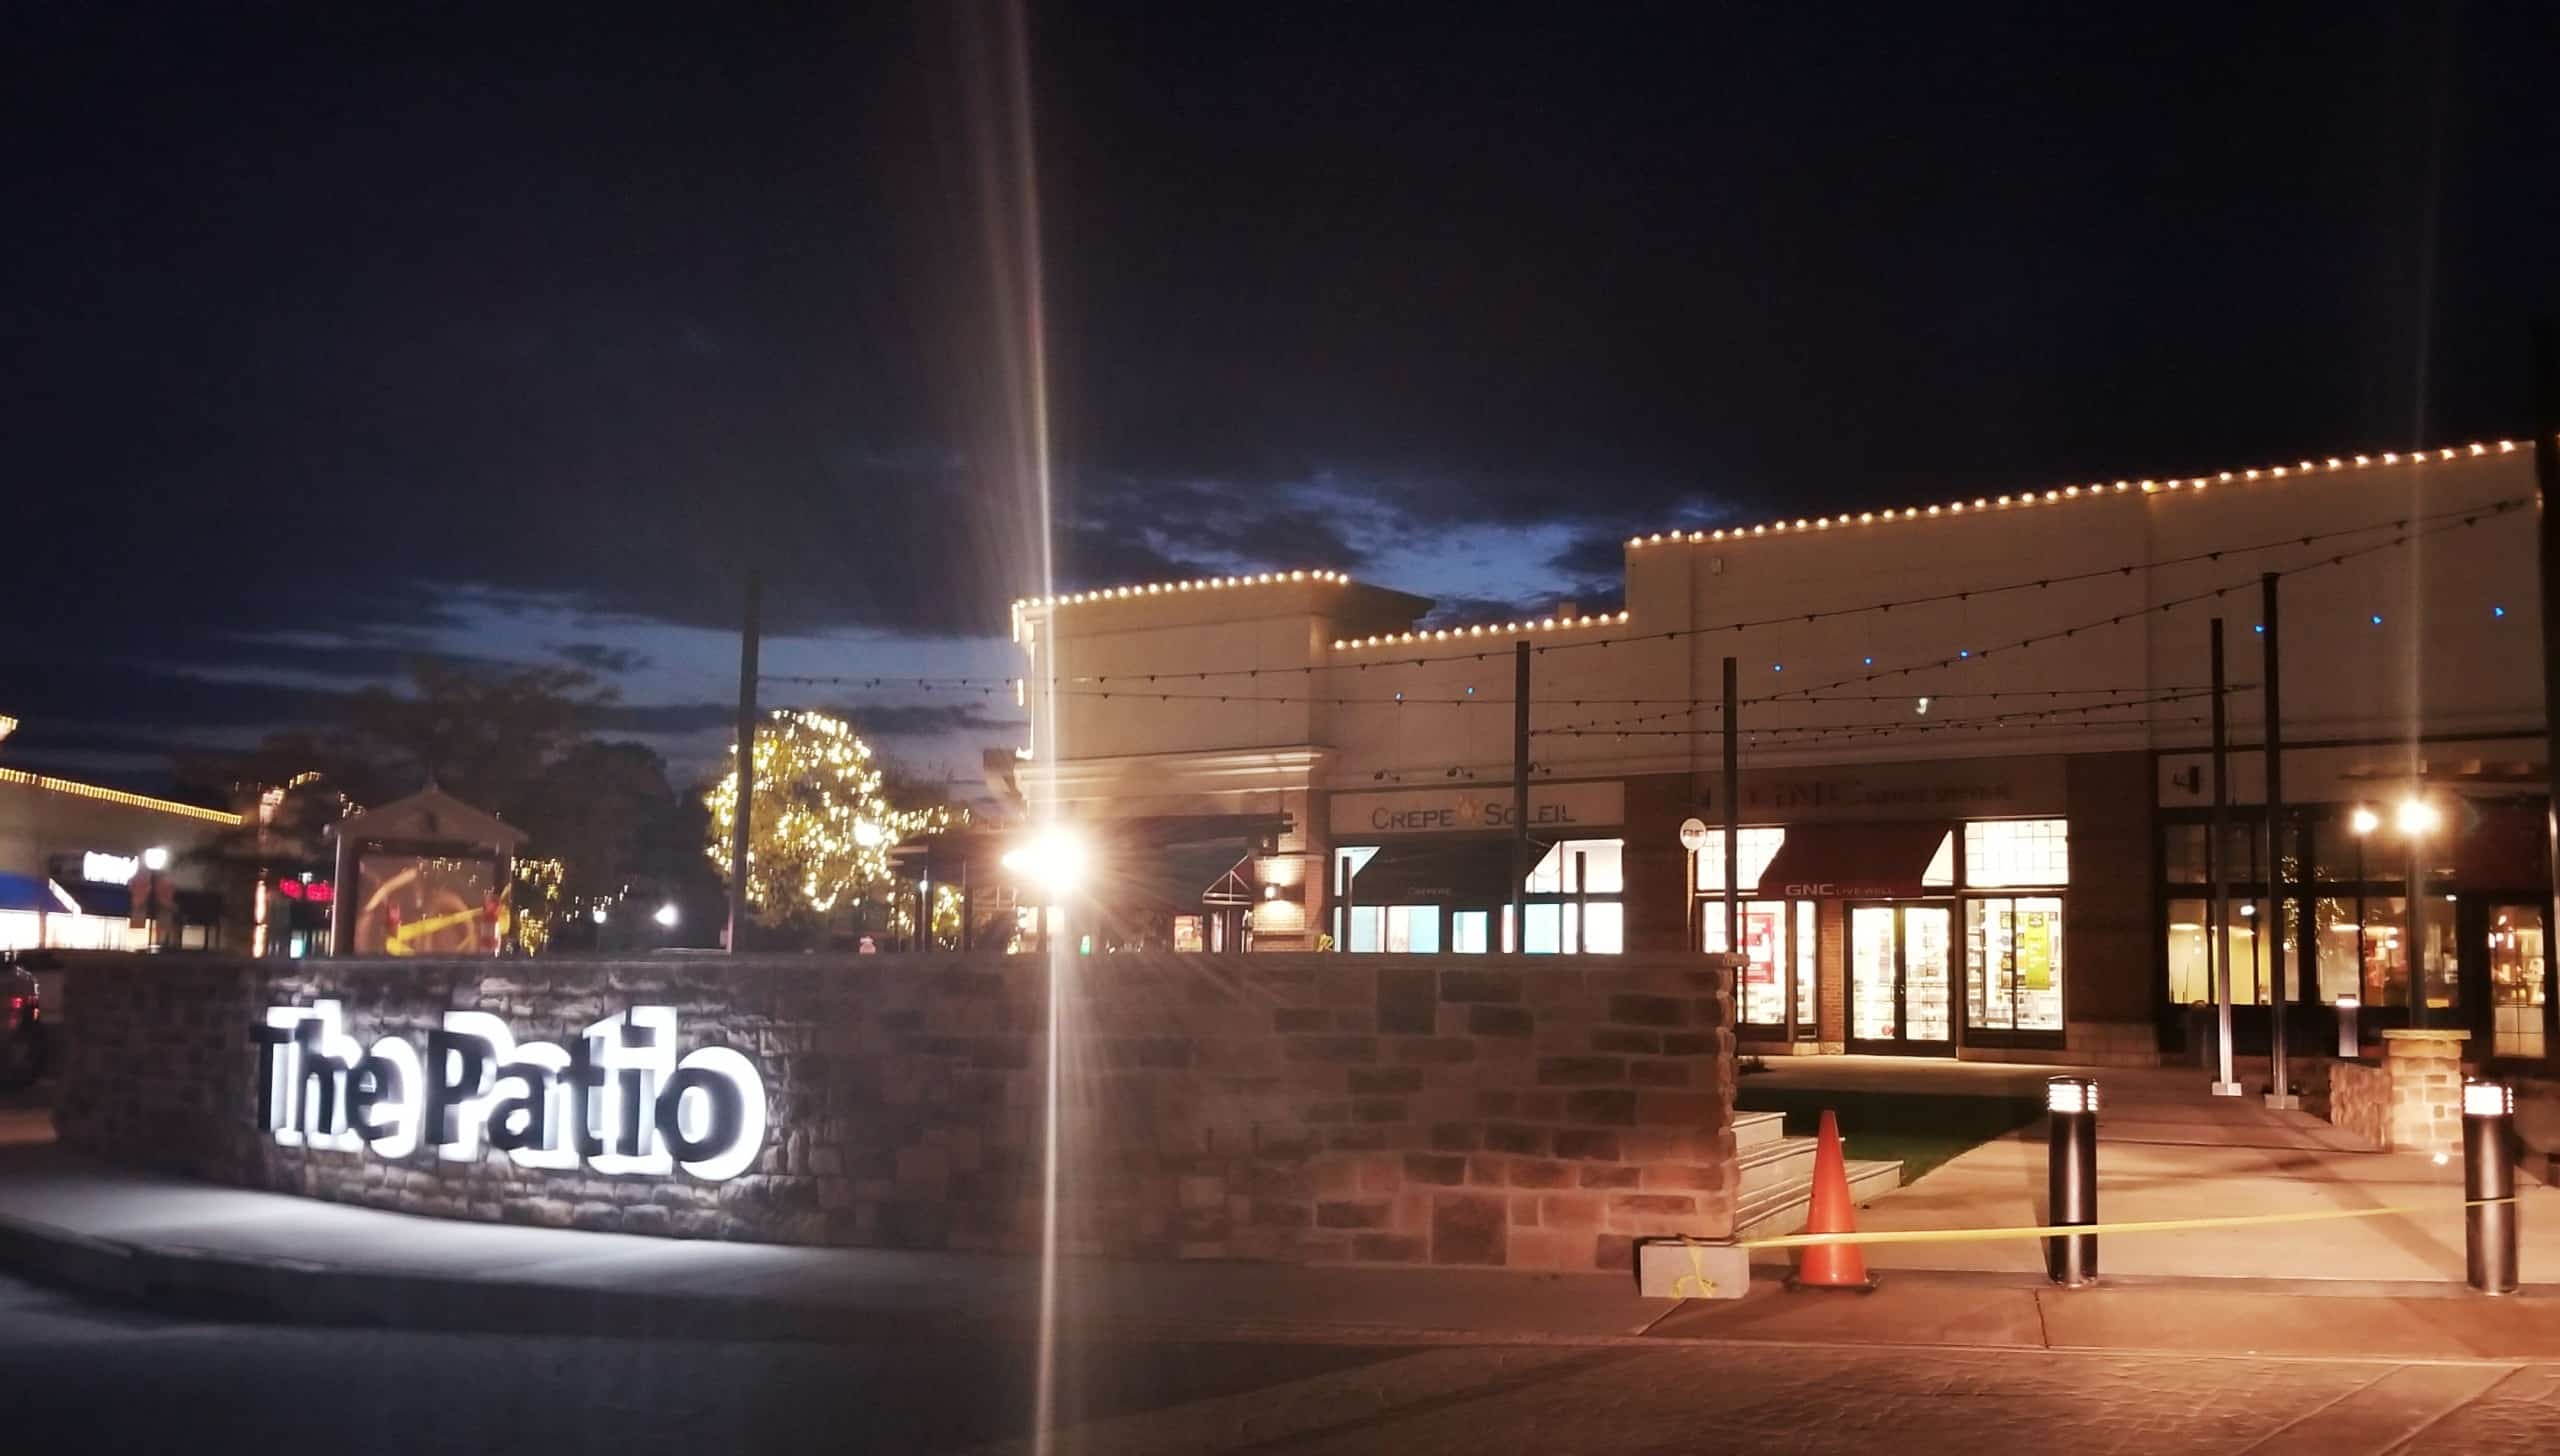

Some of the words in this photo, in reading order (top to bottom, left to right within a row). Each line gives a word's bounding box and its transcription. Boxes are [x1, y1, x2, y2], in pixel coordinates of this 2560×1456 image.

[1785, 883, 1835, 896] GNC
[250, 1008, 412, 1149] The
[426, 1012, 756, 1170] Patio
